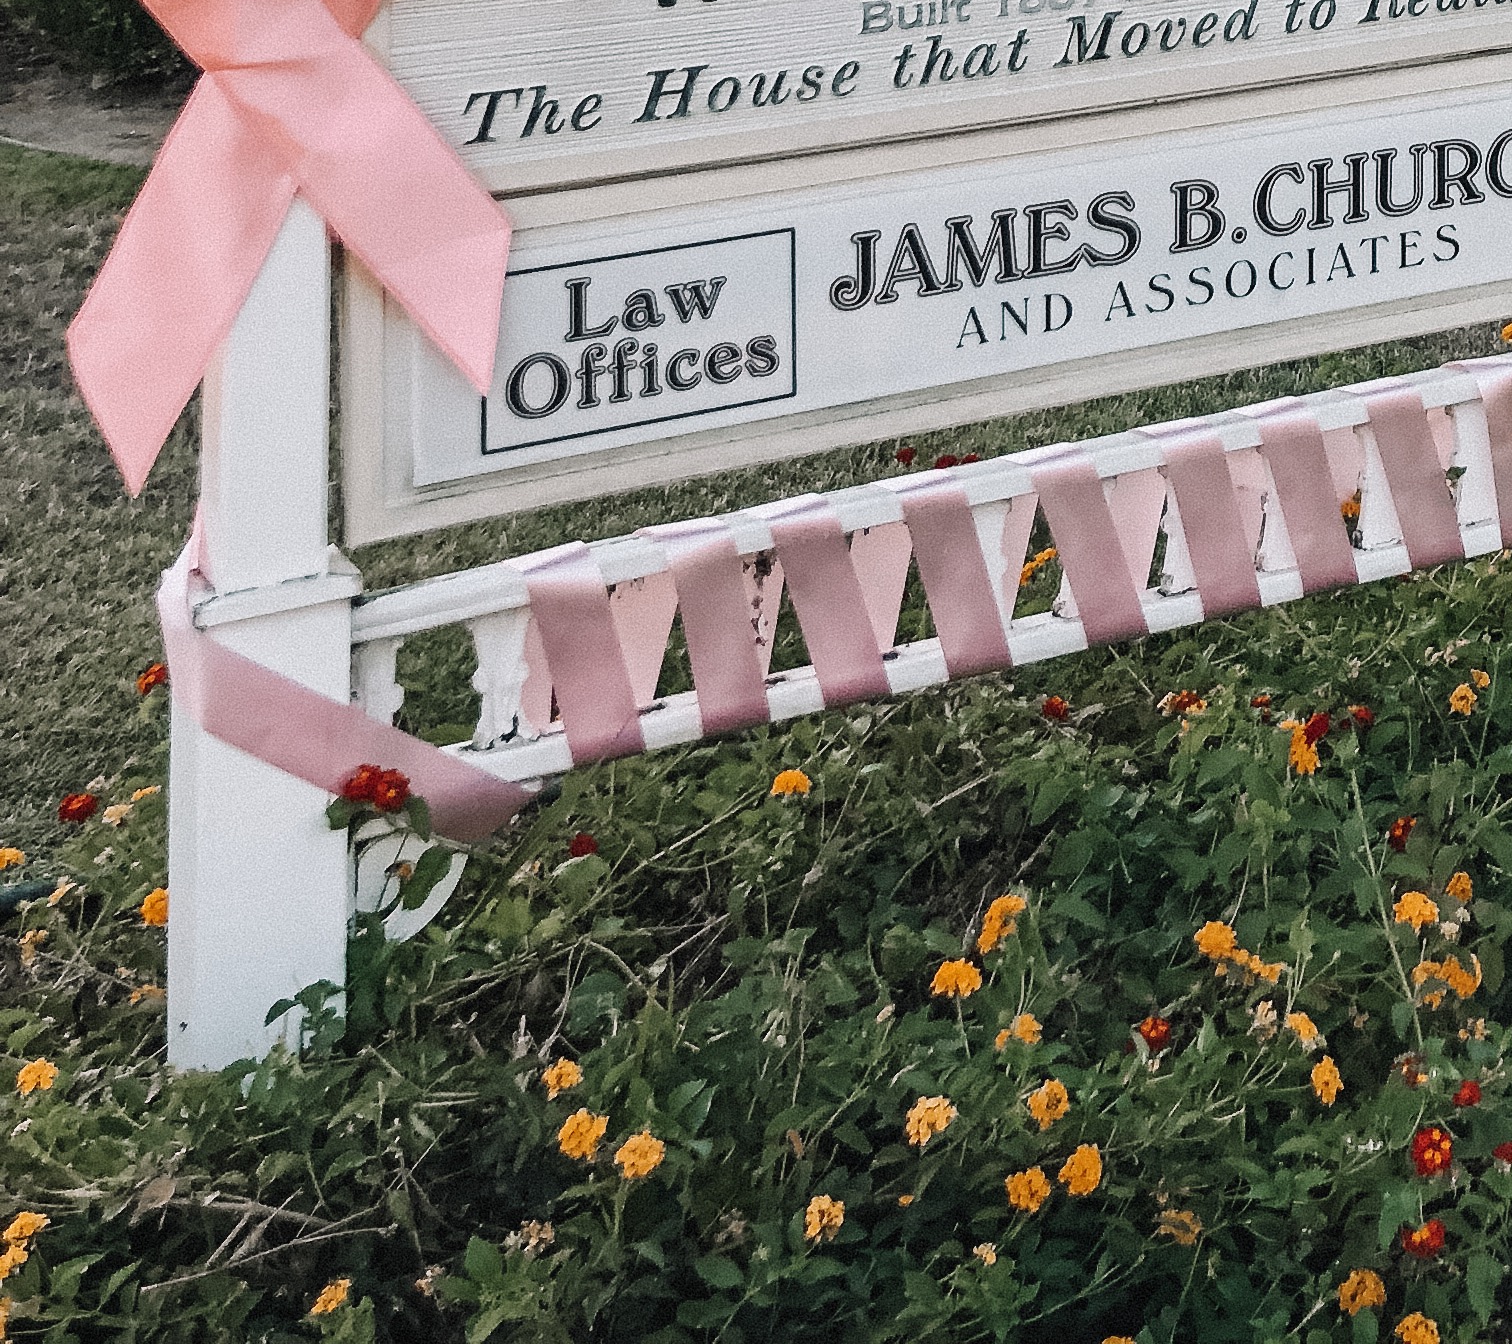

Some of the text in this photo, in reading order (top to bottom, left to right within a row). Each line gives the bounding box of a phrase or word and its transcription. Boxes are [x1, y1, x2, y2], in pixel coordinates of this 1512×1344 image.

[463, 85, 604, 147] The
[632, 58, 860, 124] House
[894, 27, 1030, 89] that
[564, 273, 728, 344] Law
[829, 191, 1142, 311] JAMES
[956, 223, 1461, 350] AND ASSOCIATES
[505, 333, 782, 421] Offices
